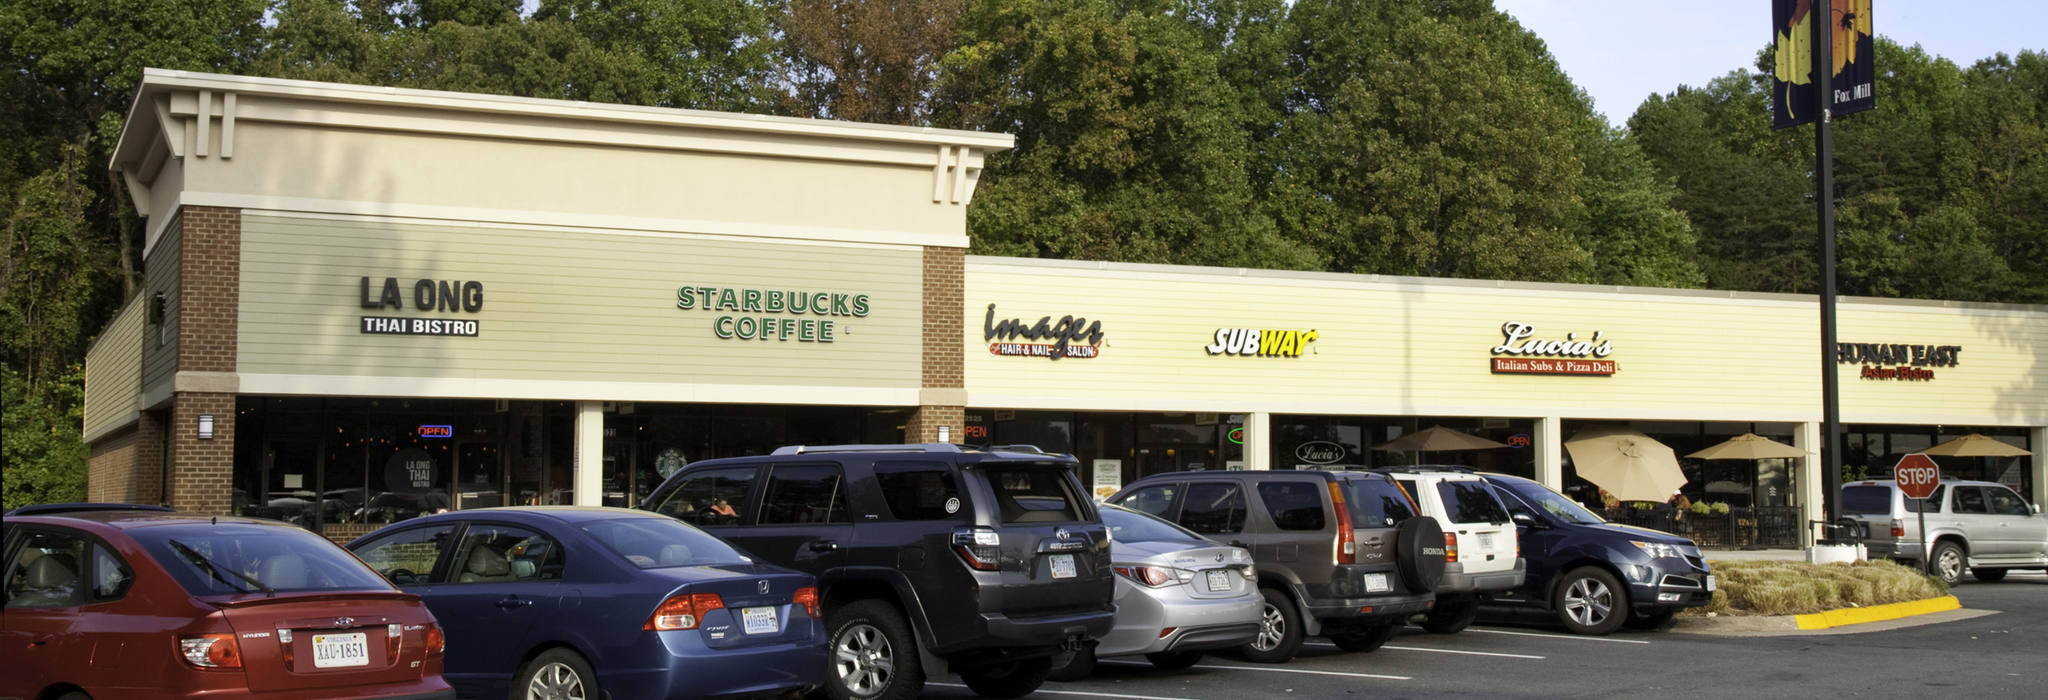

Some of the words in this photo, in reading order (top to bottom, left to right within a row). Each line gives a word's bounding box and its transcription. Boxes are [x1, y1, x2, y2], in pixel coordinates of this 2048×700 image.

[1834, 89, 1850, 104] Fox
[1853, 83, 1871, 100] Mill
[361, 276, 402, 310] LA
[414, 279, 484, 313] ONG
[677, 286, 871, 316] STARBUCKS
[364, 317, 406, 332] THAI
[412, 319, 477, 335] BISTRO
[714, 315, 834, 343] COFFEE
[984, 303, 1104, 361] images
[1206, 328, 1319, 357] SUBWAY
[1492, 320, 1615, 357] Lucia's
[1001, 344, 1021, 356] HAIR
[1023, 344, 1030, 355] &
[1031, 345, 1051, 356] NAIL
[1067, 346, 1094, 357] SALON
[1910, 345, 1962, 367] EAST
[1497, 359, 1528, 371] Italian
[1530, 360, 1553, 372] Subs
[1555, 361, 1564, 372] &
[1567, 362, 1591, 373] Pizza
[1593, 362, 1614, 373] Deli
[1861, 366, 1896, 379] Asian
[1897, 366, 1935, 381] Bistro
[417, 427, 449, 436] OPEN
[963, 425, 987, 438] PEN
[1507, 435, 1530, 447] OPEN
[1303, 445, 1339, 460] Lucia's
[406, 460, 414, 470] LA
[415, 460, 431, 470] ONG
[409, 469, 430, 481] THAI
[1898, 467, 1936, 485] STOP
[1422, 547, 1445, 556] HONDA
[410, 660, 421, 669] GT
